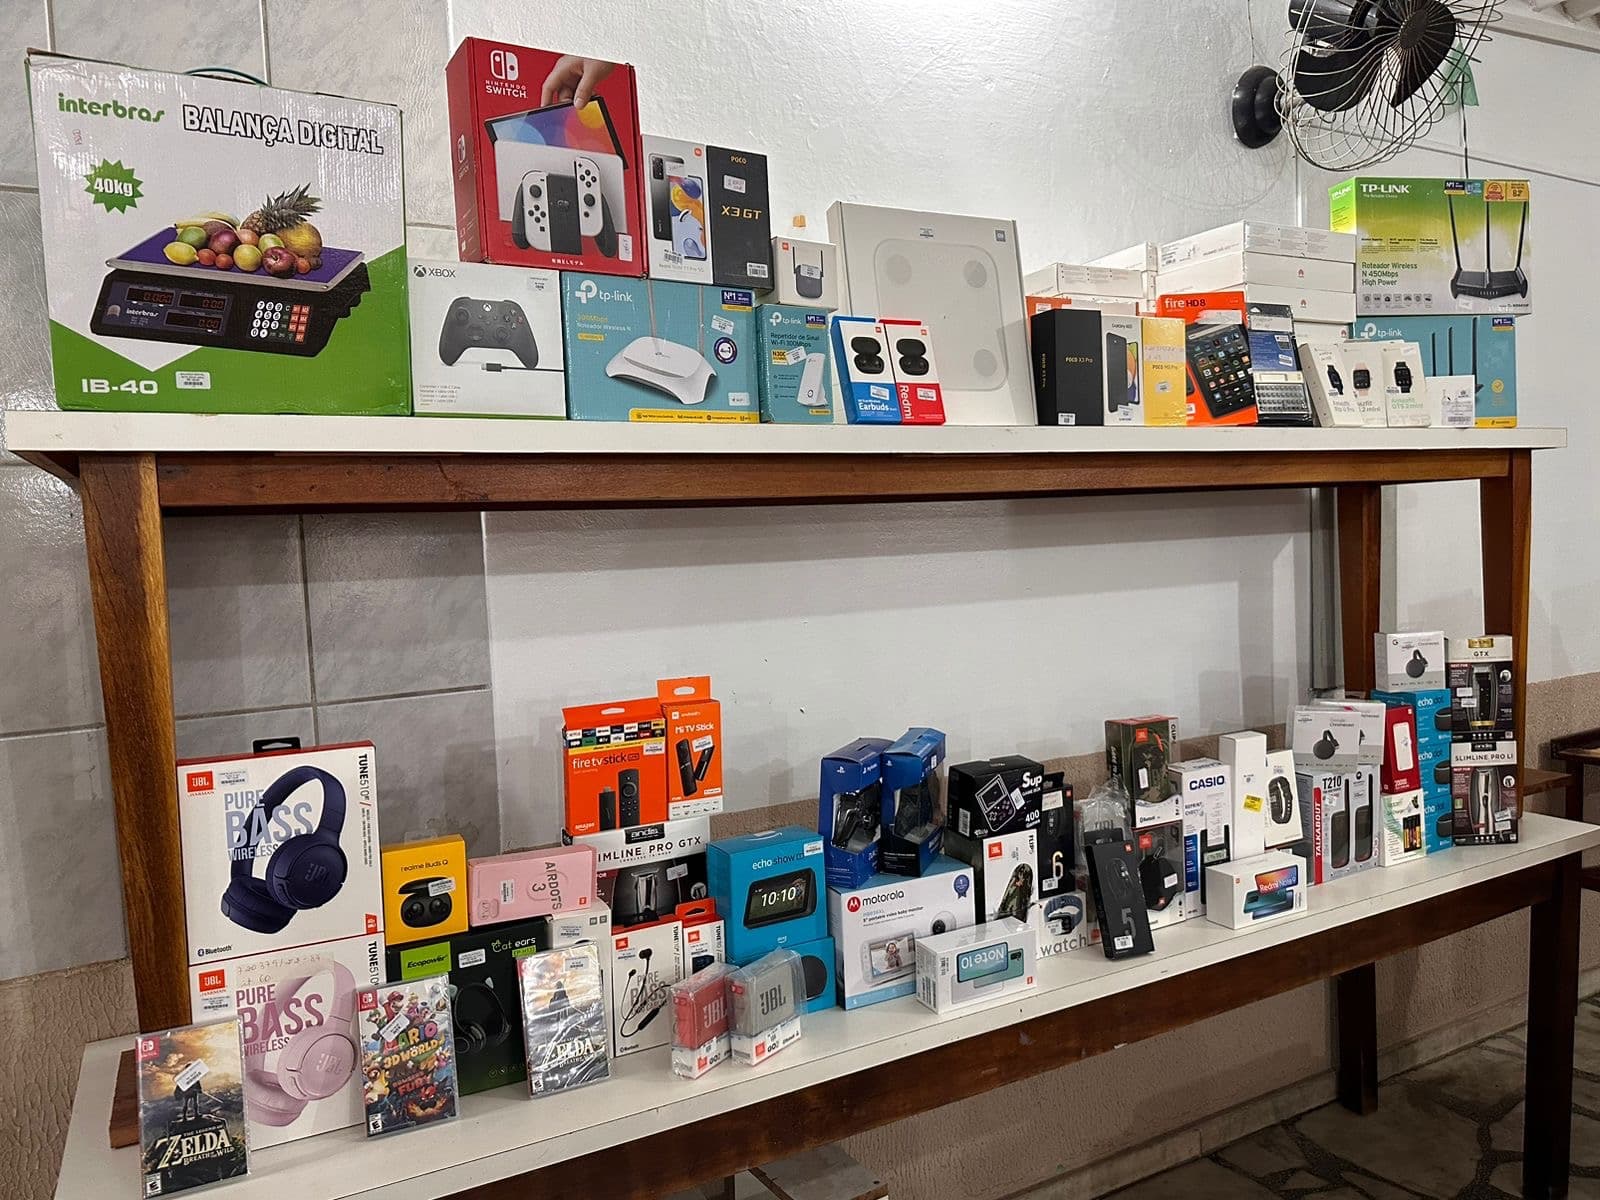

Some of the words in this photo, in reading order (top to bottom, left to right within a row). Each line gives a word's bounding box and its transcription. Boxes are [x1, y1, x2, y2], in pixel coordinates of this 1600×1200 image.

[486, 80, 526, 90] NINTENDO
[486, 85, 527, 98] SWITCH
[58, 92, 165, 123] interbras
[183, 104, 294, 147] BALANÇA
[298, 119, 384, 155] DIGITAL
[730, 154, 747, 165] POCO
[93, 176, 133, 198] 40kg
[1360, 184, 1410, 194] TP-LINK
[721, 205, 740, 217] X3
[743, 208, 762, 220] GT
[428, 268, 456, 278] XBOX
[1361, 262, 1390, 270] Roteador
[1391, 262, 1418, 270] Wireless
[1368, 270, 1398, 278] 450Mbps
[1362, 279, 1376, 287] High
[599, 290, 632, 302] tp-link
[1164, 298, 1185, 308] fire
[1200, 299, 1206, 307] 8
[770, 332, 797, 341] Repetidor
[1377, 328, 1402, 338] tp-link
[82, 378, 159, 395] IB-40
[859, 402, 890, 412] Earbuds
[899, 385, 914, 420] Redmi
[1418, 697, 1433, 708] echo
[696, 722, 714, 731] Stick
[572, 758, 590, 768] fire
[591, 758, 602, 766] tv
[602, 752, 627, 764] stick
[1418, 752, 1433, 760] echo
[1455, 754, 1488, 762] SLIMLINE
[192, 778, 209, 787] JBL
[1022, 772, 1043, 788] Sup
[1189, 775, 1226, 790] CASIO
[1322, 775, 1342, 790] T210
[224, 789, 265, 810] PURE
[1025, 809, 1040, 822] 400
[1424, 805, 1435, 814] cho
[226, 802, 314, 849] BASS
[575, 822, 595, 830] amazon
[1314, 802, 1322, 857] TALKABOUT
[228, 844, 279, 862] WIRELESS
[598, 847, 642, 862] IMLINE
[648, 842, 673, 854] PRO
[678, 836, 701, 848] GTX
[401, 862, 424, 872] realme
[425, 860, 442, 870] Buds
[752, 858, 772, 870] echo
[774, 854, 794, 865] show
[1052, 850, 1064, 880] 6
[532, 882, 547, 893] 3
[544, 861, 563, 910] AIRDOTS
[1259, 881, 1279, 892] Redmi
[761, 886, 797, 906] 10:10
[862, 890, 904, 906] motorola
[1121, 908, 1136, 938] 5
[204, 944, 232, 956] Bluetooth
[514, 938, 536, 948] ears
[1040, 934, 1088, 956] watch
[406, 954, 448, 969] Ecopower
[204, 975, 222, 986] JBL
[637, 970, 659, 986] PRE
[236, 984, 276, 1008] PURE
[760, 984, 786, 1016] JBL
[238, 994, 324, 1044] BASS
[703, 996, 728, 1029] JBL
[384, 1054, 400, 1068] 3D
[400, 1040, 439, 1061] WORLD
[316, 1052, 342, 1074] JBL
[398, 1074, 431, 1096] FURY
[155, 1128, 232, 1169] ZELDA
[183, 1153, 210, 1166] BREATH
[216, 1147, 235, 1158] WILD
